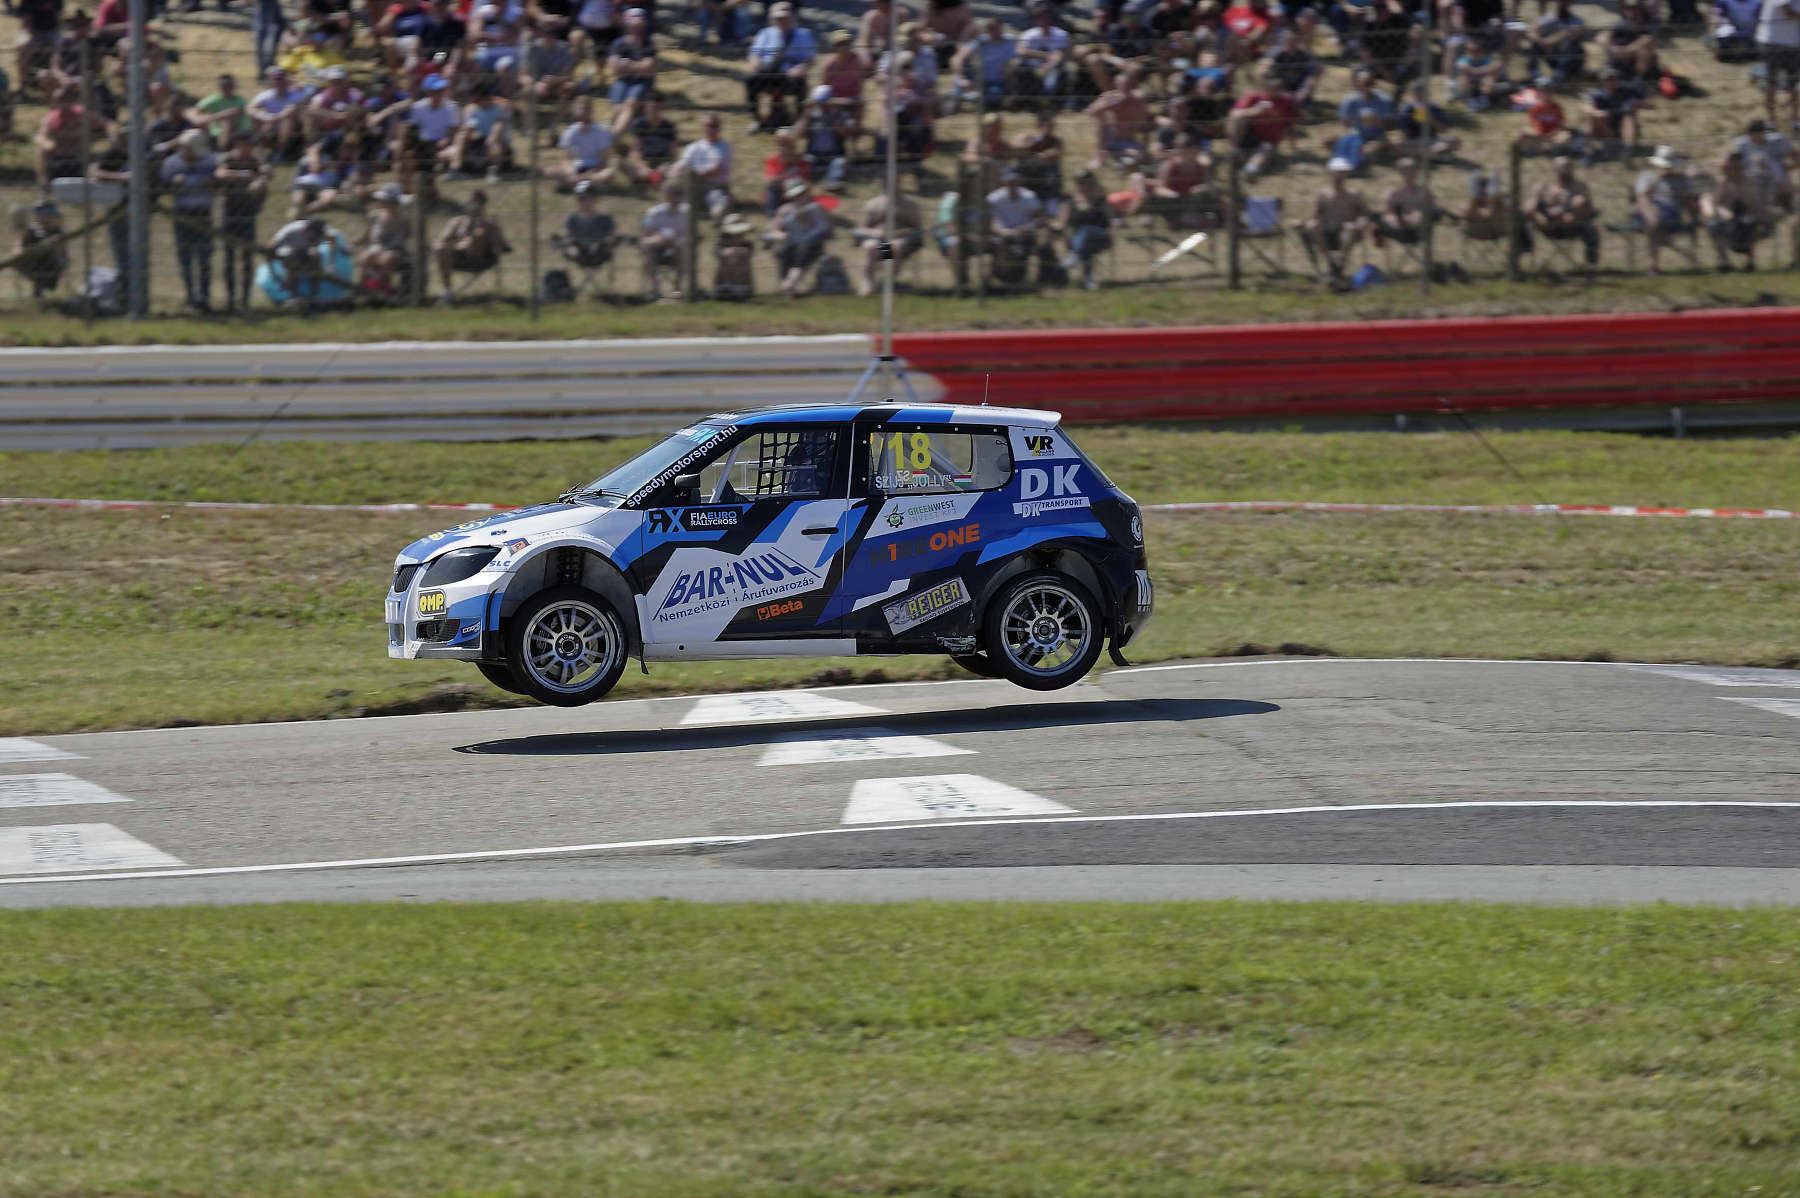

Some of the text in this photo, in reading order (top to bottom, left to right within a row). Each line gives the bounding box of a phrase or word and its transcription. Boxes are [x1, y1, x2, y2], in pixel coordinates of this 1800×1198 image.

[888, 432, 931, 469] 18
[1024, 436, 1053, 450] VR
[627, 424, 738, 508] speedymotorsport.hu
[1021, 464, 1081, 500] DK
[908, 500, 955, 516] GREENWEST
[1022, 499, 1083, 518] DK TRANSPORT
[690, 518, 738, 526] RALLYCROSS
[662, 553, 807, 609] BAR-NUL
[419, 594, 444, 612] OMP
[659, 576, 815, 623] Nemzetközi Árufuvarozás
[771, 600, 803, 617] Beta
[908, 582, 960, 619] REIGER
